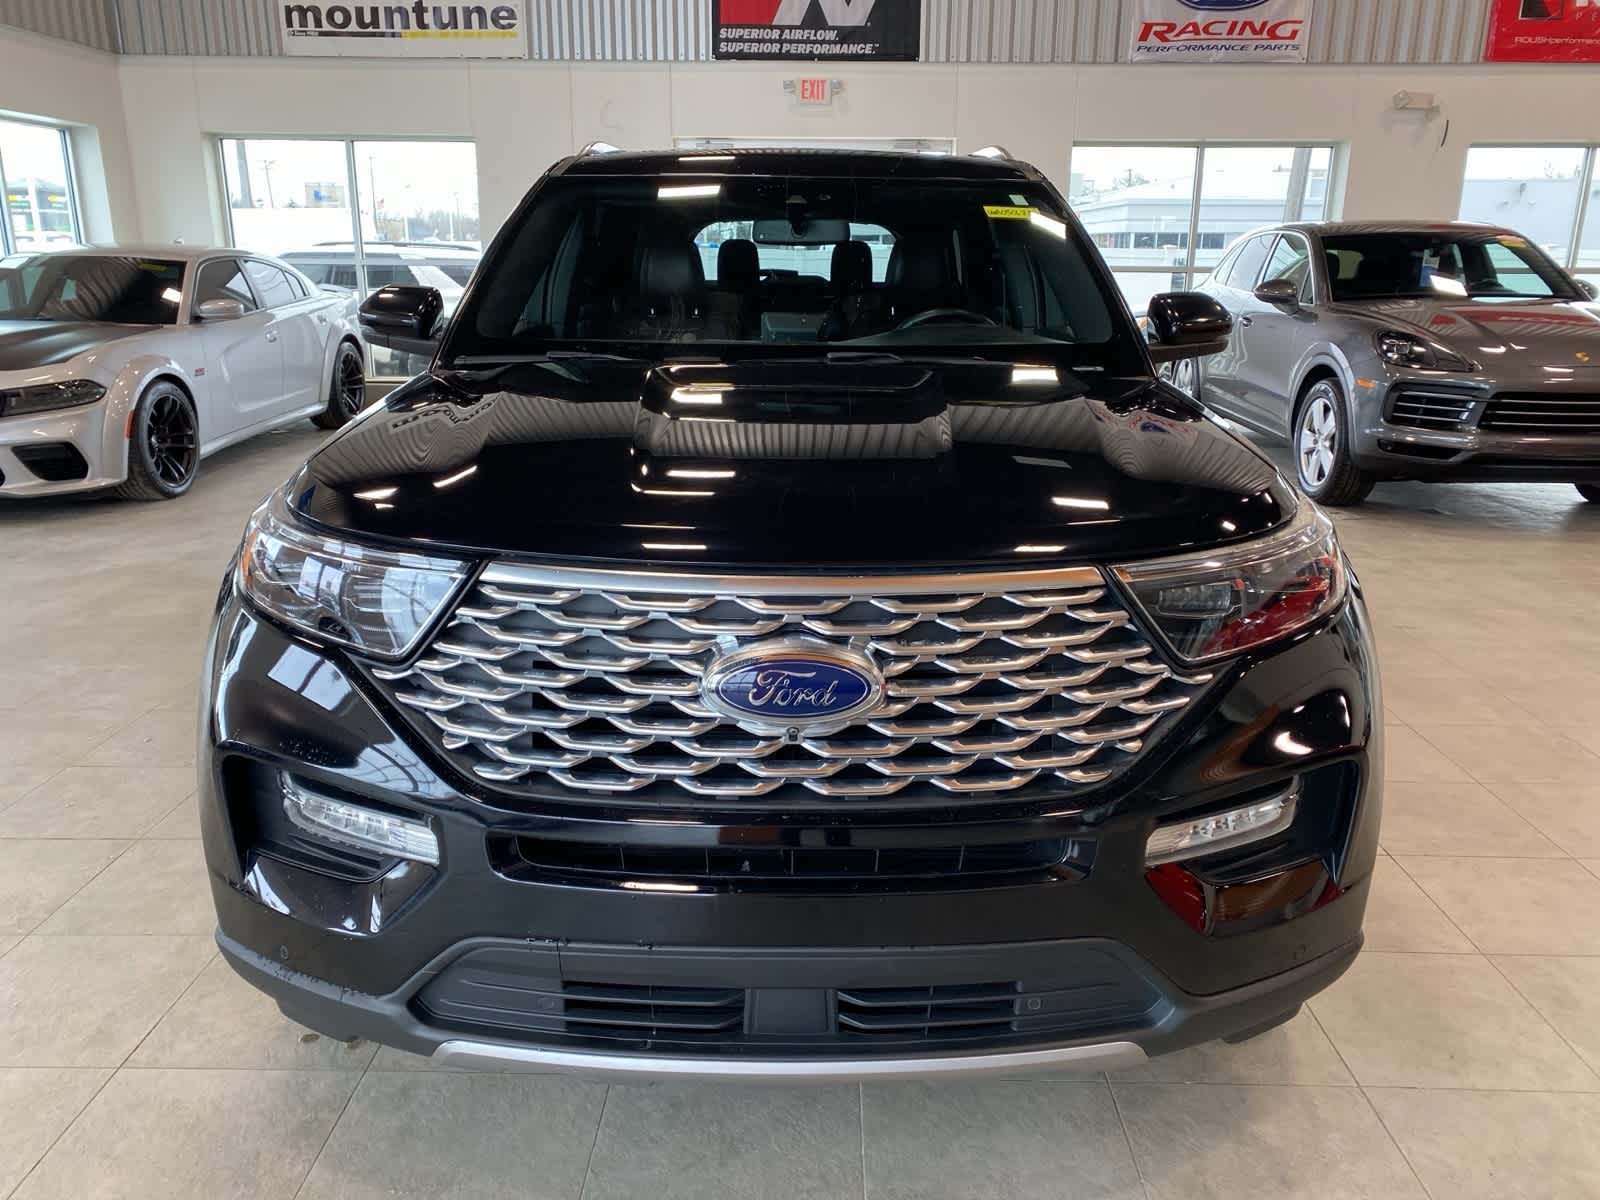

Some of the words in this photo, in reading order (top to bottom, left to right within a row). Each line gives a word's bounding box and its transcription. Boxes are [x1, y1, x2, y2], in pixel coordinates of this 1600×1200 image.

[284, 0, 518, 30] mountune
[719, 28, 780, 39] SUPERIOR
[781, 29, 839, 41] AIRFLOW.
[1138, 20, 1304, 43] RACING
[719, 42, 780, 53] SUPERIOR
[1136, 44, 1249, 53] PERFORMANCE
[801, 79, 826, 100] EXIT
[749, 669, 838, 707] Ford
